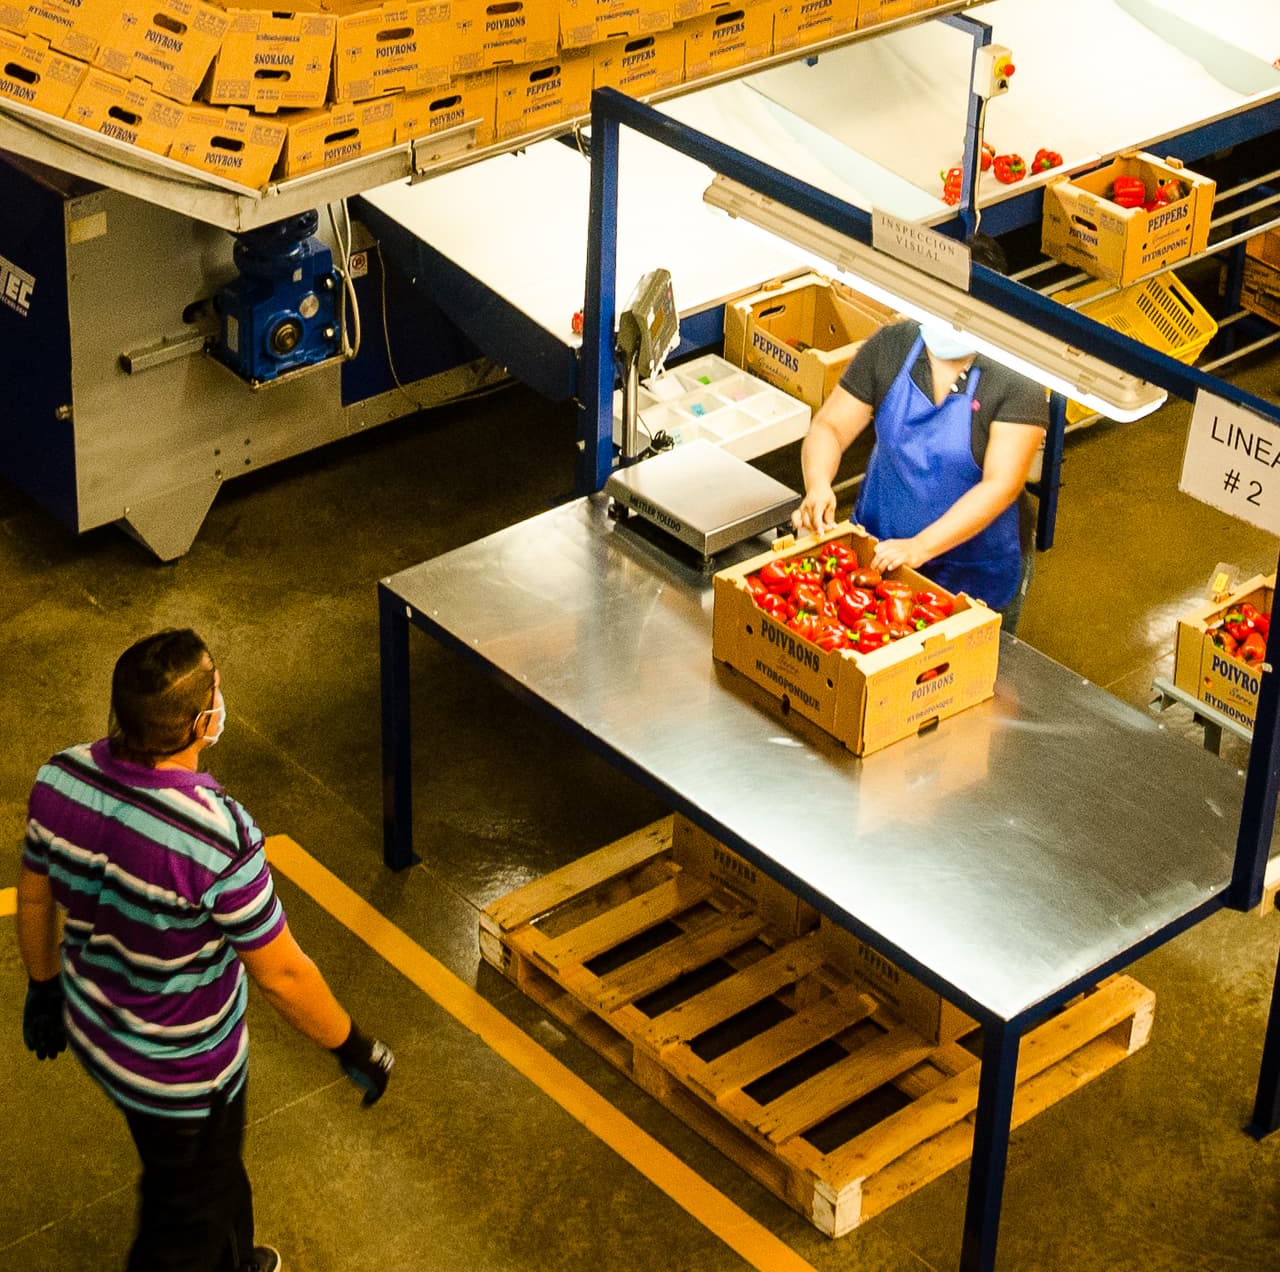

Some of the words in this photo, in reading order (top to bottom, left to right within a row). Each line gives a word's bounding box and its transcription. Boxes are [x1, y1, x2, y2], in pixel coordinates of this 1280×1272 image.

[28, 5, 74, 28] HYDROPONIC
[486, 16, 526, 32] POIVRONS
[144, 29, 182, 53] POIVRONS
[712, 22, 745, 40] PEPPERS
[254, 53, 294, 65] POIVRONS
[376, 42, 416, 58] POIVRONS
[622, 49, 655, 66] PEPPERS
[526, 79, 561, 96] PEPPERS
[429, 109, 465, 128] POIVRONS
[100, 122, 138, 145] POIVRONS
[204, 152, 244, 168] POIVRONS
[324, 142, 362, 160] POIVRONS
[1148, 204, 1188, 233] PEPPERS
[881, 216, 956, 256] INSPECCION
[895, 236, 941, 263] VISUAL
[1142, 237, 1188, 264] HYDROPONIC
[752, 332, 799, 373] PEPPERS
[1224, 469, 1240, 493] #
[1246, 480, 1262, 506] 2
[760, 616, 820, 673] POIVRONS
[755, 659, 820, 712] HYDROPONIQUE
[1212, 654, 1259, 695] POIVRO
[911, 673, 955, 701] POIVRONS
[1204, 692, 1256, 728] HYDROPON
